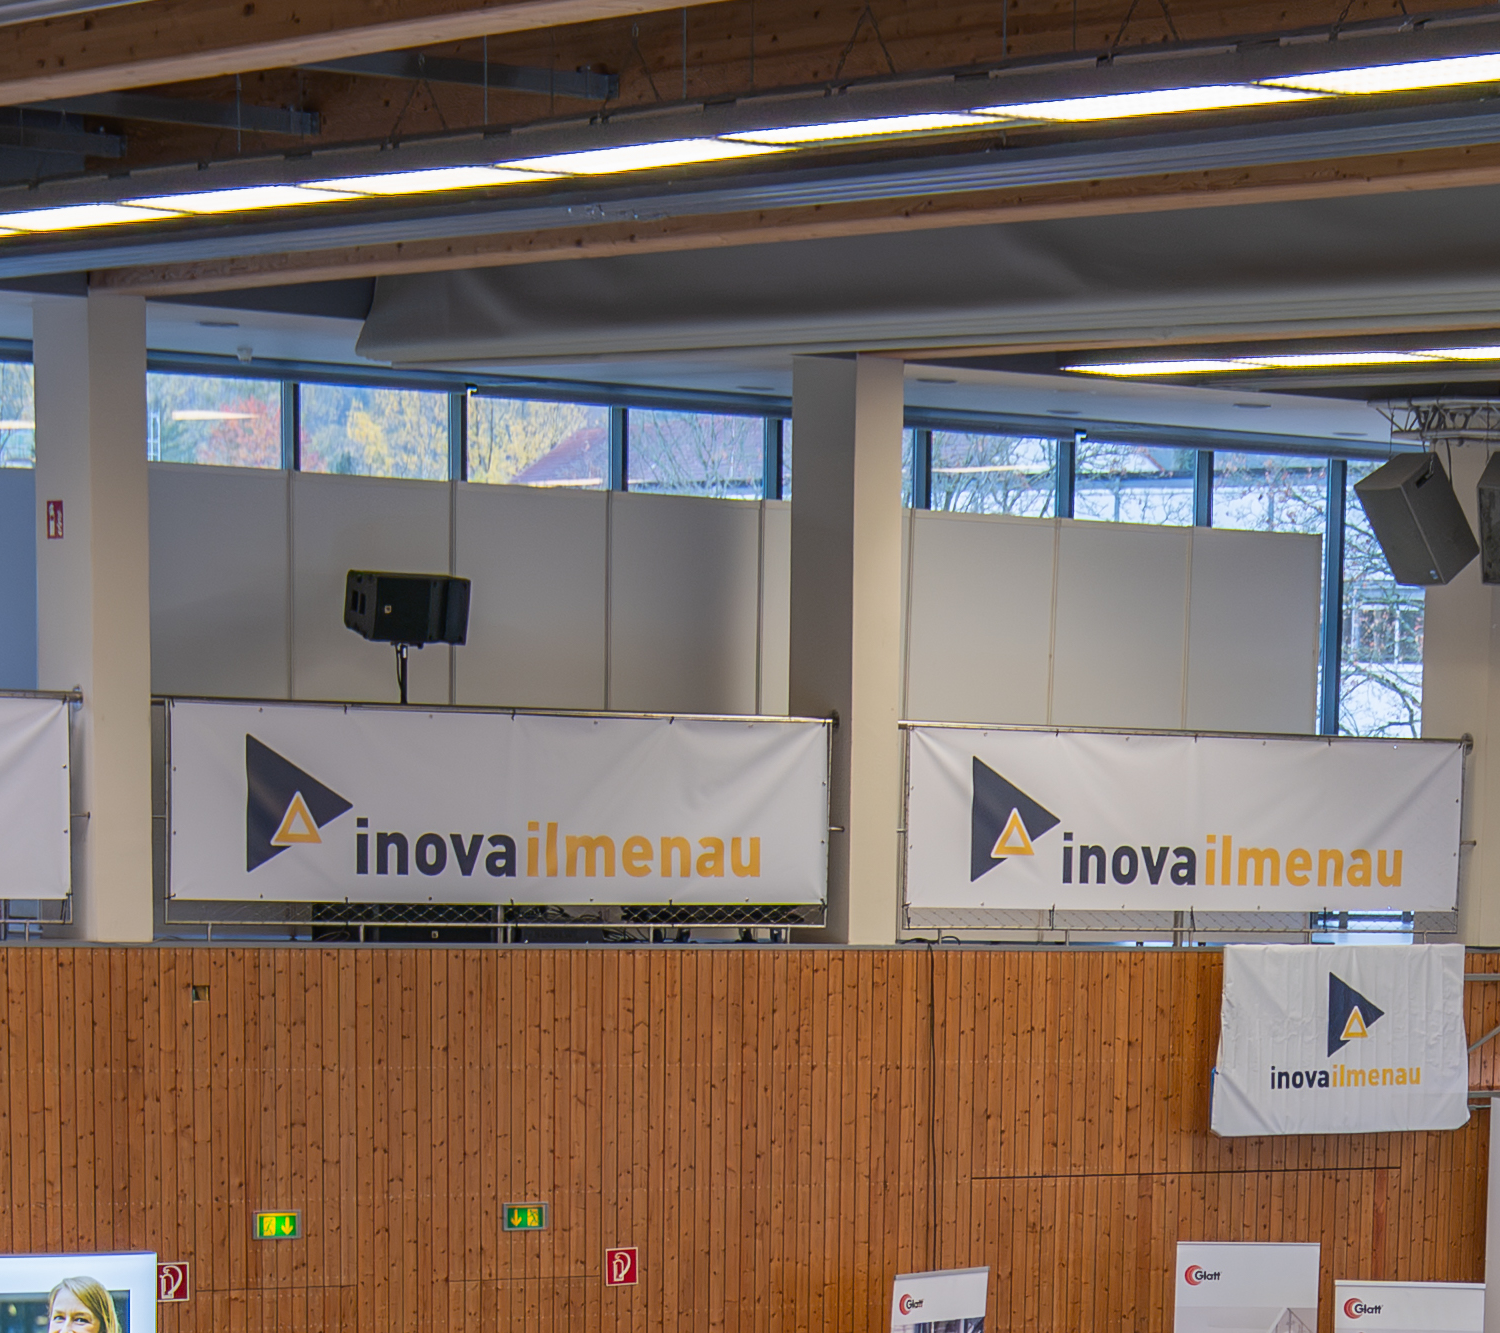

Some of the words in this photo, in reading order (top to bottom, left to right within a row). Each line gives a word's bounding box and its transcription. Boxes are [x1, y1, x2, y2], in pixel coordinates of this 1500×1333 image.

[355, 816, 762, 879] inovailmenau
[1062, 831, 1403, 887] inovailmenau
[1270, 1063, 1421, 1090] inovailmenau
[1195, 1271, 1221, 1281] Glatt
[1354, 1303, 1382, 1315] Glatt
